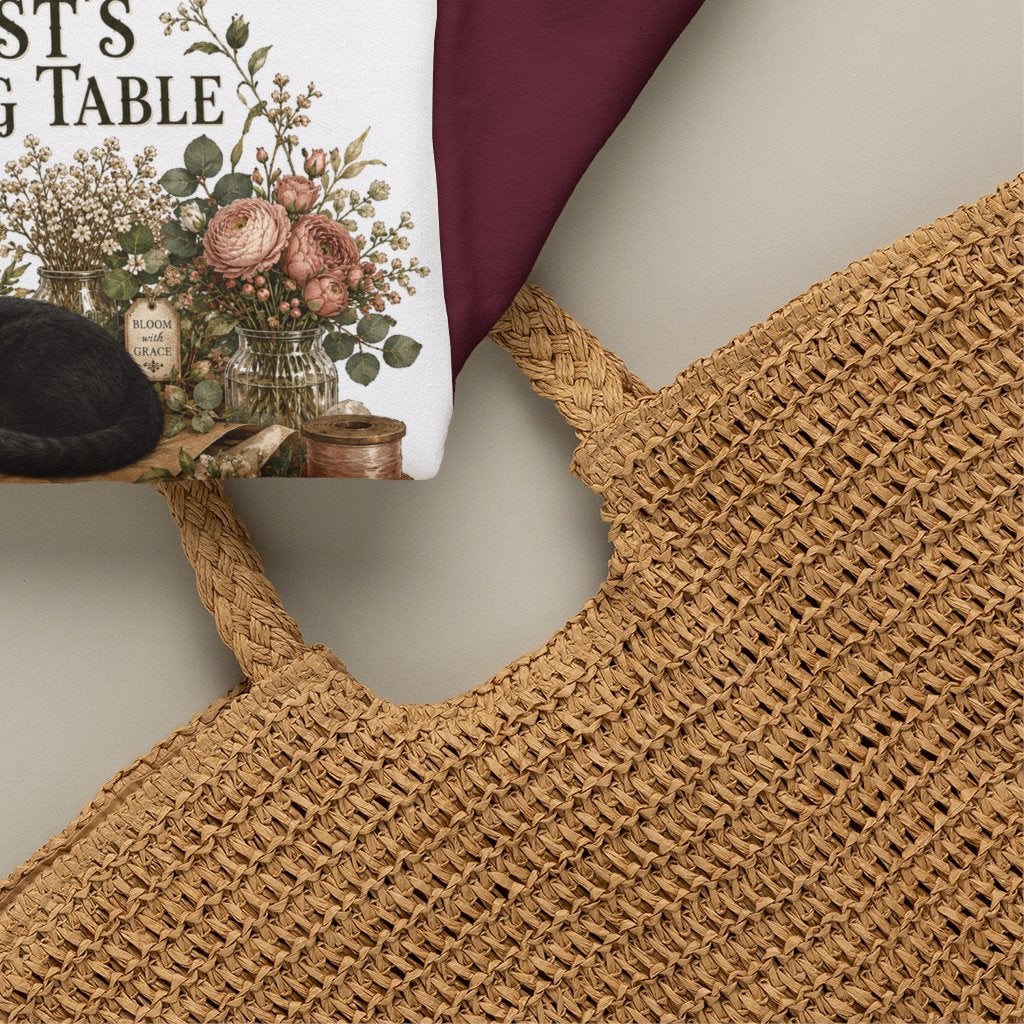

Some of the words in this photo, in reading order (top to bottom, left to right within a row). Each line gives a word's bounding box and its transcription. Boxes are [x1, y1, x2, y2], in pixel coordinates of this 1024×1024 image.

[35, 63, 226, 128] TABLE
[132, 319, 172, 329] BLOOM
[142, 331, 164, 342] with
[133, 346, 172, 356] GRACE
